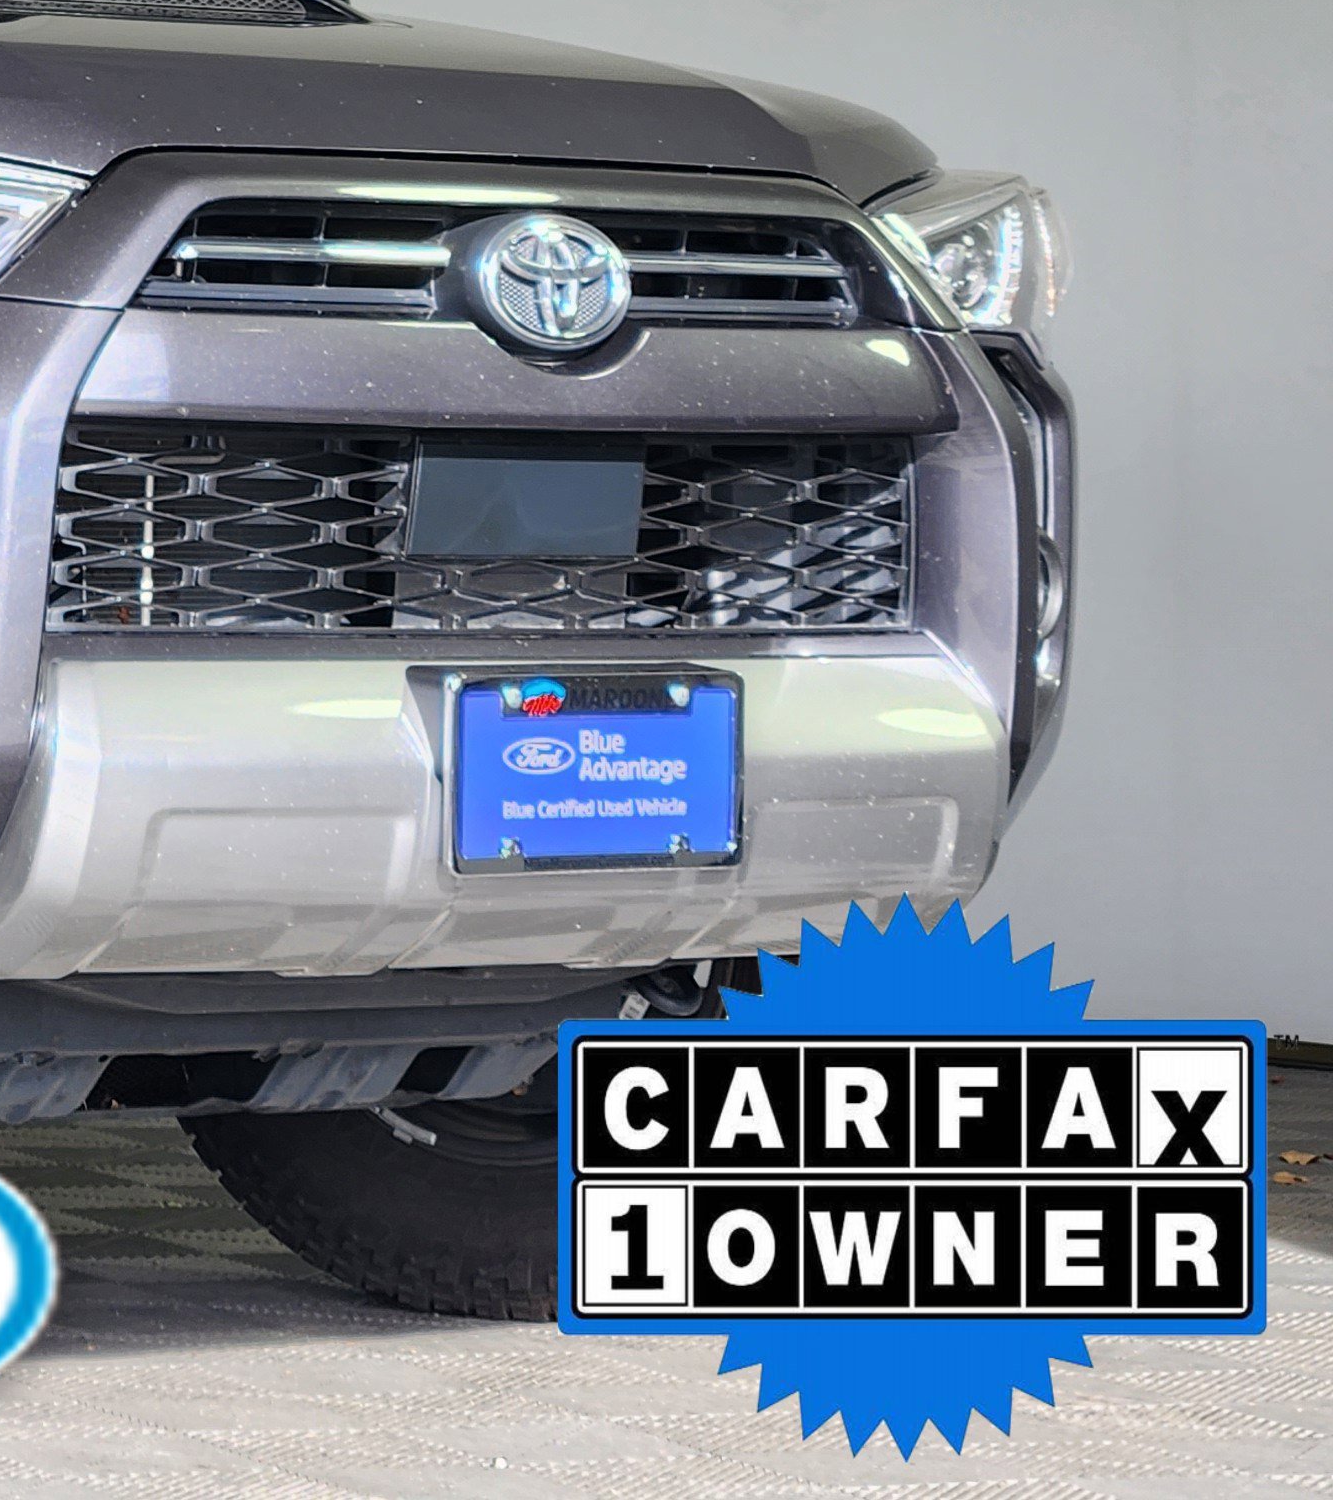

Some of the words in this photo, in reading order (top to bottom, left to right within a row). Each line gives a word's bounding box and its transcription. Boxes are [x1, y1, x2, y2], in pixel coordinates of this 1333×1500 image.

[578, 729, 625, 754] Blue
[516, 743, 562, 768] Ford
[578, 756, 688, 784] Advantage
[502, 800, 535, 820] Blue
[537, 799, 595, 819] Certified
[597, 798, 634, 817] Used
[634, 797, 688, 817] Vehicle
